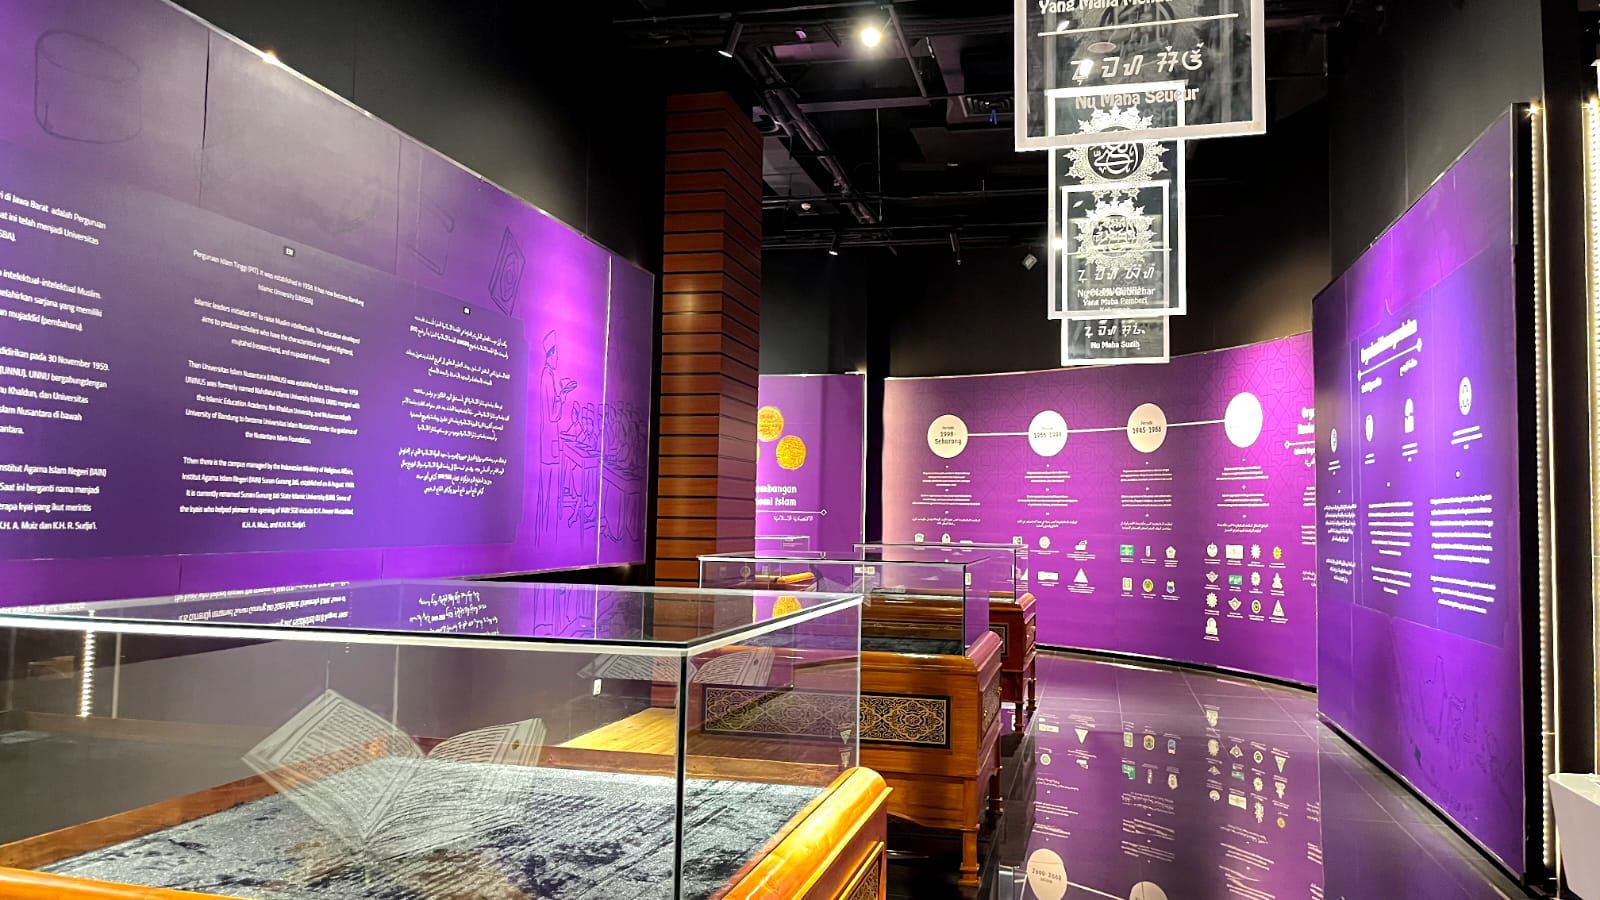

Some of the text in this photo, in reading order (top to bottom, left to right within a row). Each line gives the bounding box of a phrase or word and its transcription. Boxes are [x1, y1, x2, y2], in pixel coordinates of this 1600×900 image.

[1038, 0, 1075, 14] Yang
[1075, 87, 1199, 109] Nu Maha Seueur
[4, 193, 11, 201] di
[30, 200, 48, 212] Barat
[51, 208, 72, 219] adalah
[74, 213, 106, 229] Perguruan
[9, 213, 17, 222] ini
[19, 216, 36, 227] telah
[36, 223, 63, 234] menjadi
[64, 229, 99, 245] Universitas
[34, 298, 58, 307] sarjana
[60, 303, 76, 313] yang
[30, 353, 46, 361] pada
[58, 356, 90, 368] November
[39, 391, 52, 399] dan
[53, 392, 88, 403] Universitas
[17, 407, 52, 417] Nusantara
[60, 411, 82, 420] bawah
[24, 465, 48, 475] Agama
[49, 466, 66, 474] Islam
[68, 467, 88, 476] Negeri
[16, 483, 26, 491] ini
[26, 484, 54, 494] berganti
[74, 486, 100, 495] menjadi
[775, 496, 797, 506] Islam
[19, 503, 34, 512] kyai
[34, 505, 51, 513] yang
